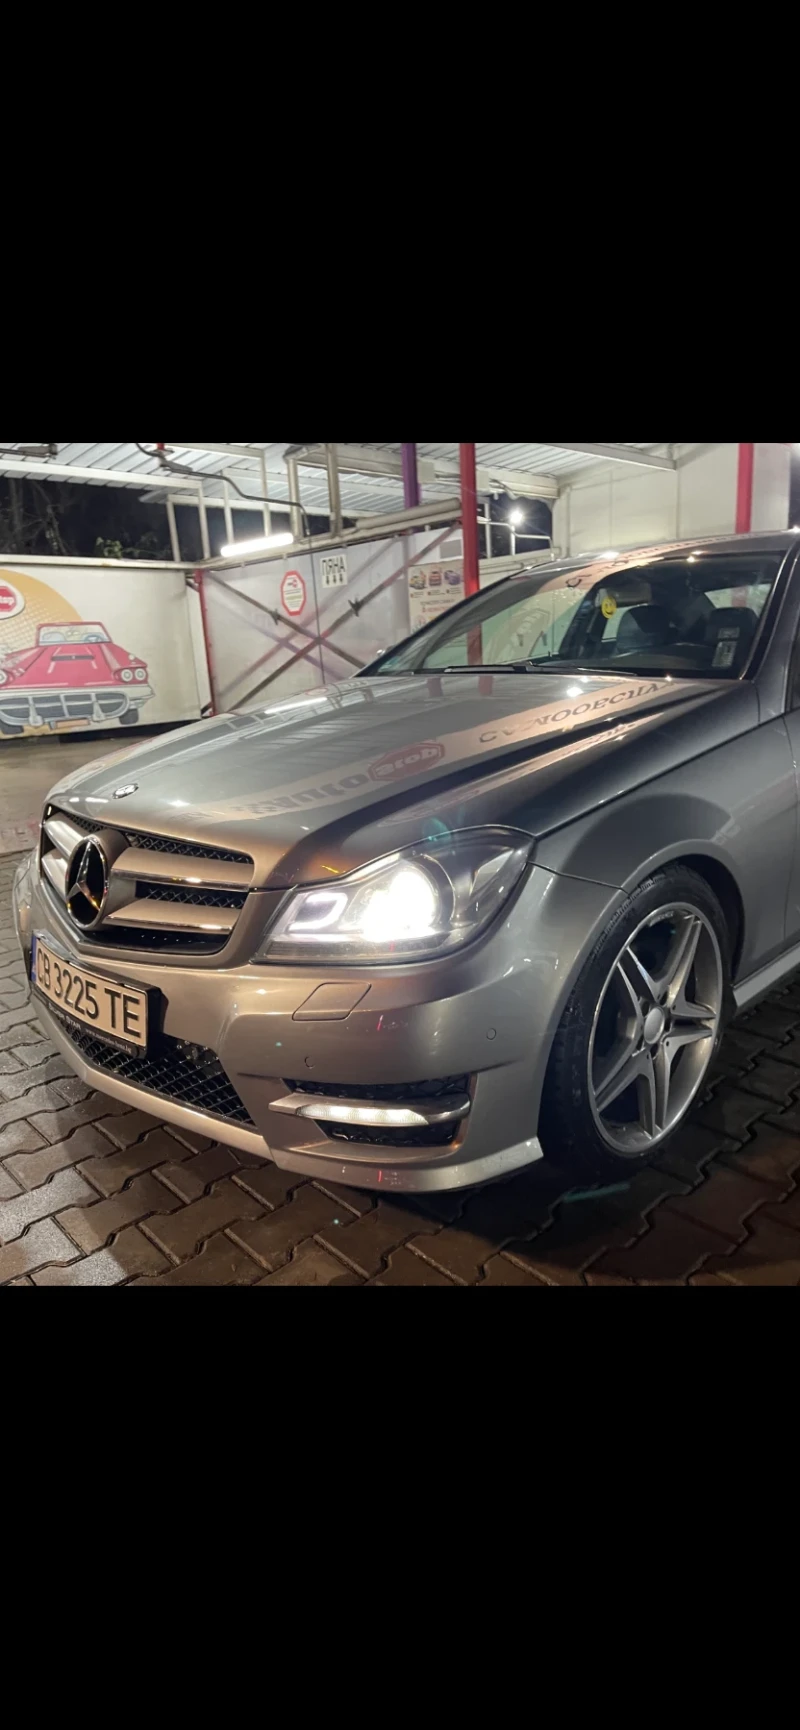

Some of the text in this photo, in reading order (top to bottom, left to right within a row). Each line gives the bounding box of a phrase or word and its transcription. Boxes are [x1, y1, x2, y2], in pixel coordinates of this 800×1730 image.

[322, 556, 346, 576] ПЯНА
[37, 947, 141, 1039] CB 3225 TE
